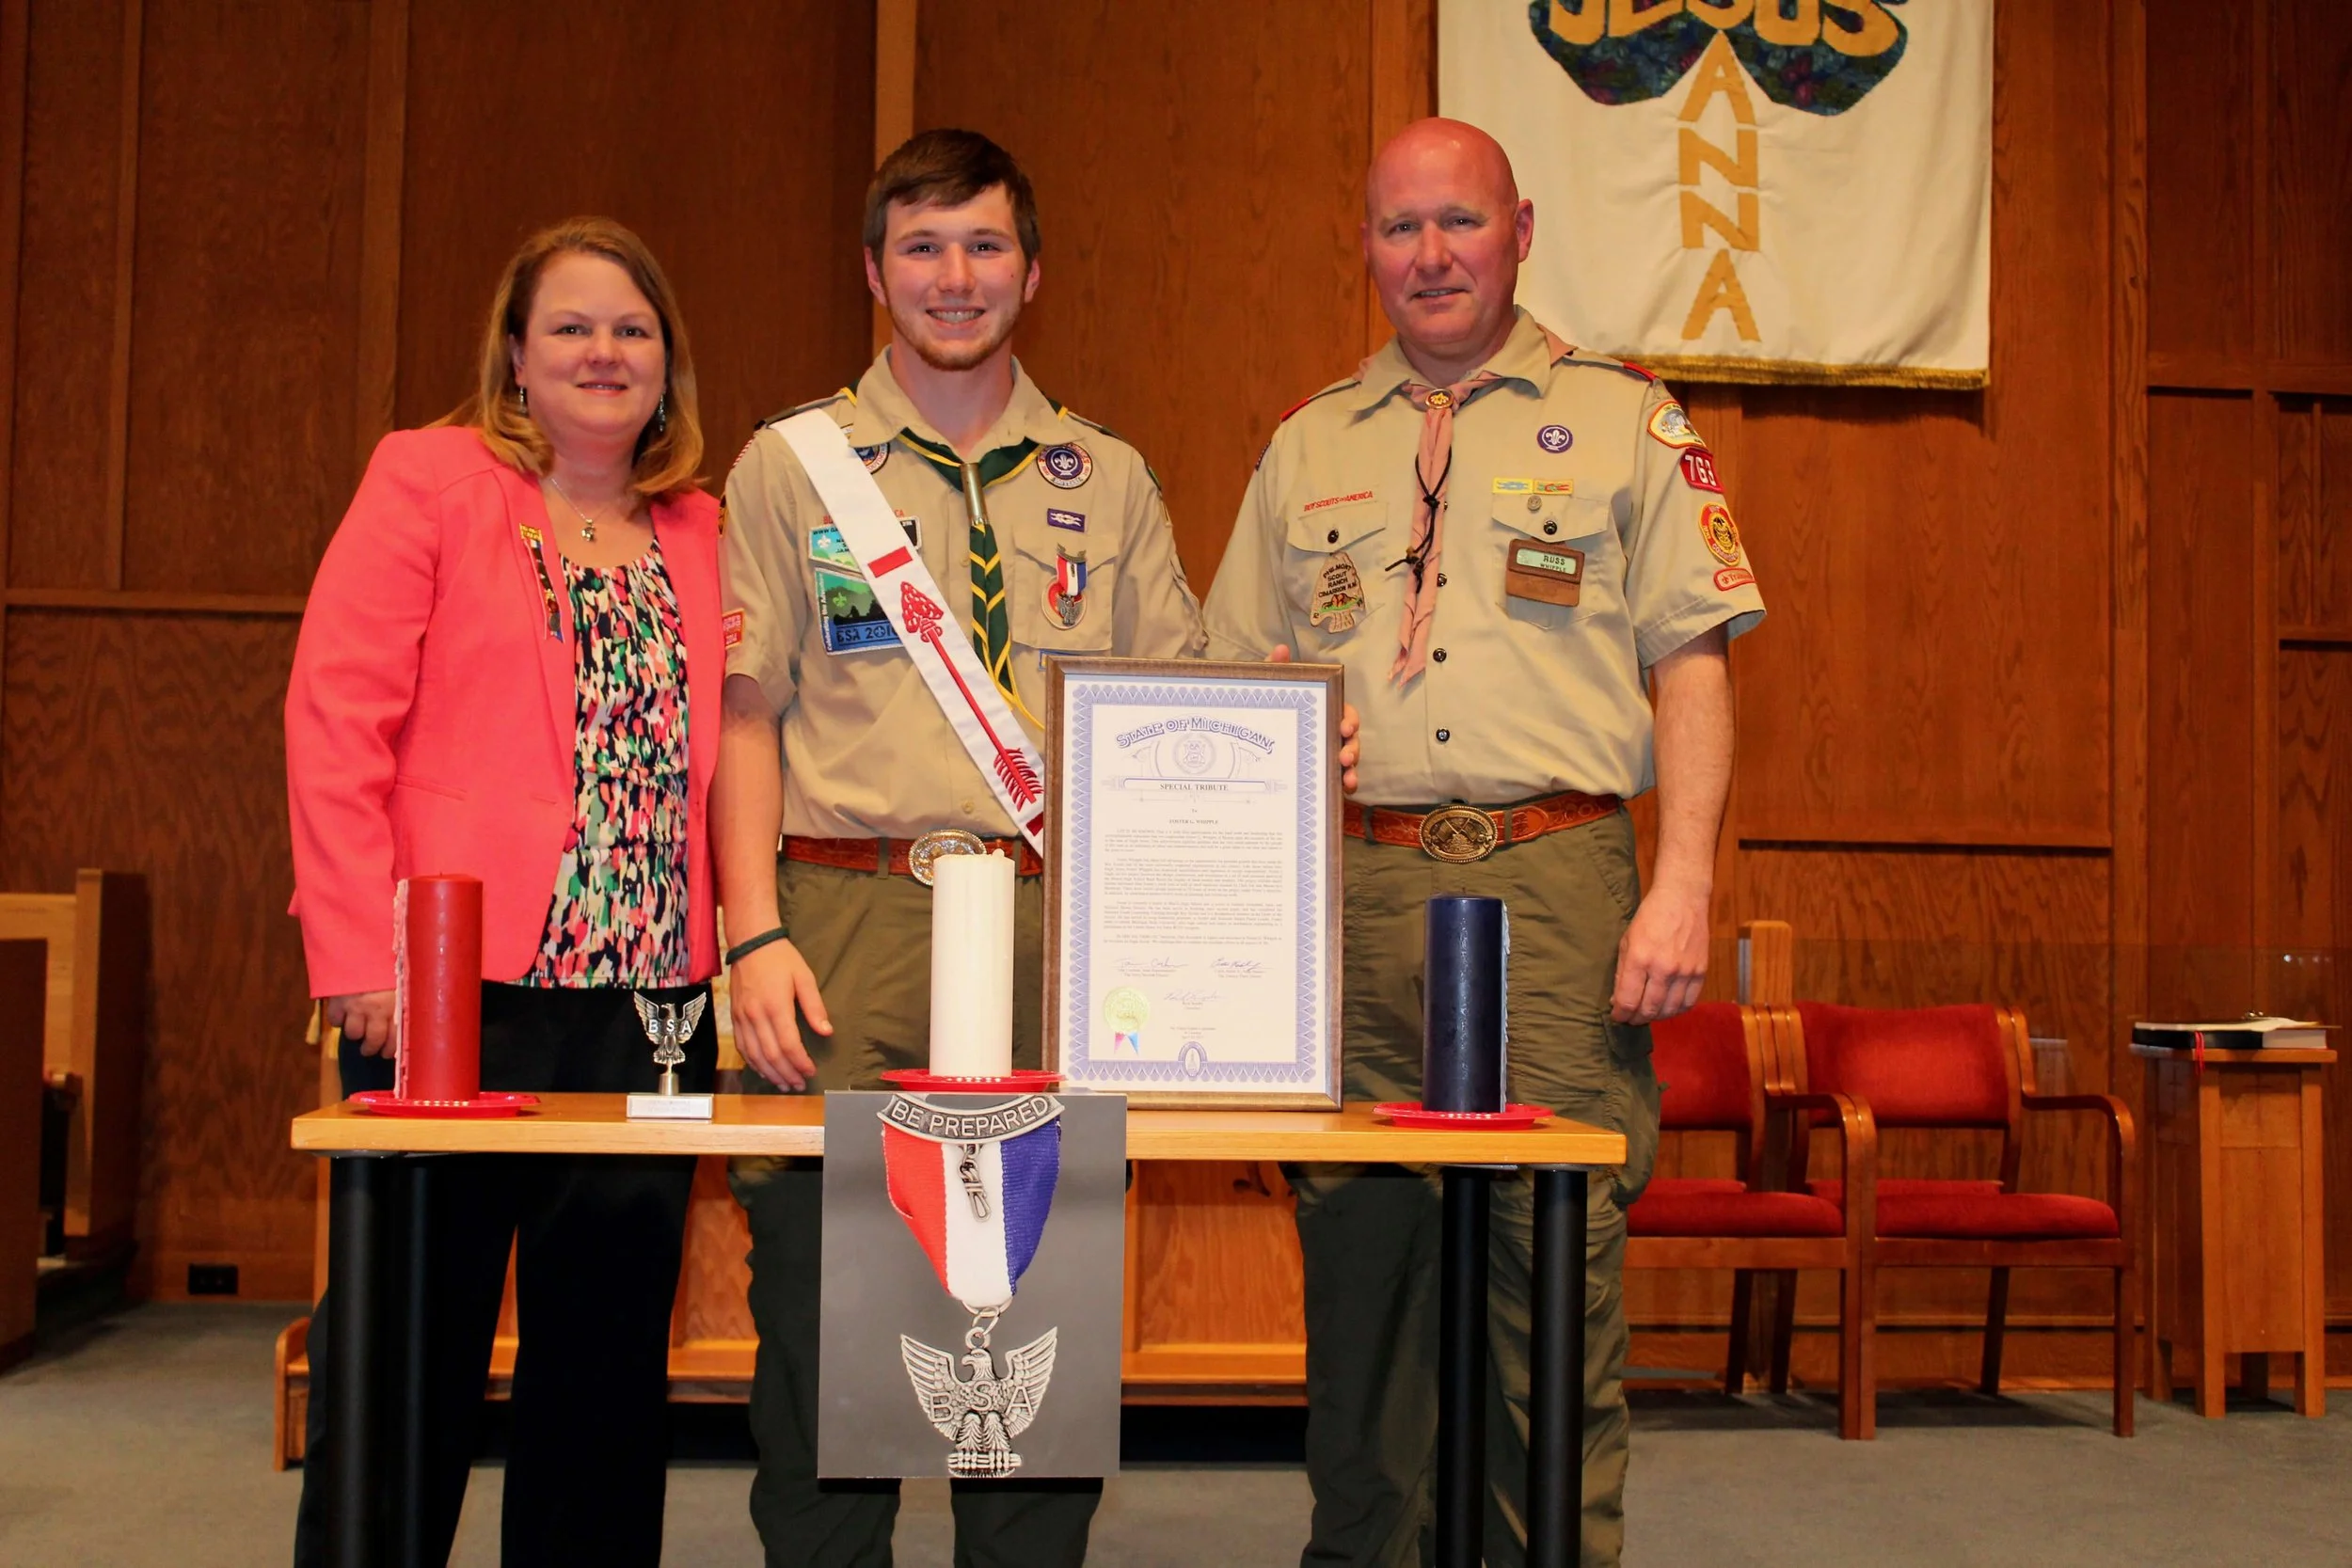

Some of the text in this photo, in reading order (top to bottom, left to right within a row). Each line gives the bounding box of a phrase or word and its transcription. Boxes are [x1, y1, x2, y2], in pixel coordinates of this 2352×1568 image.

[1685, 454, 1717, 486] 763
[1317, 498, 1339, 508] SCOUTS
[1344, 491, 1374, 502] AMERICA
[1540, 563, 1566, 572] WHIPPLE
[1543, 555, 1565, 565] RUSS
[1323, 563, 1352, 578] PHILMONT
[1327, 571, 1347, 581] SCOUT
[1327, 578, 1348, 589] RANCH
[1318, 585, 1346, 598] CIMARRON
[836, 627, 861, 642] BSA
[1117, 716, 1275, 754] STATE OF MICHIGAN
[890, 1096, 1050, 1137] BE PREPARED
